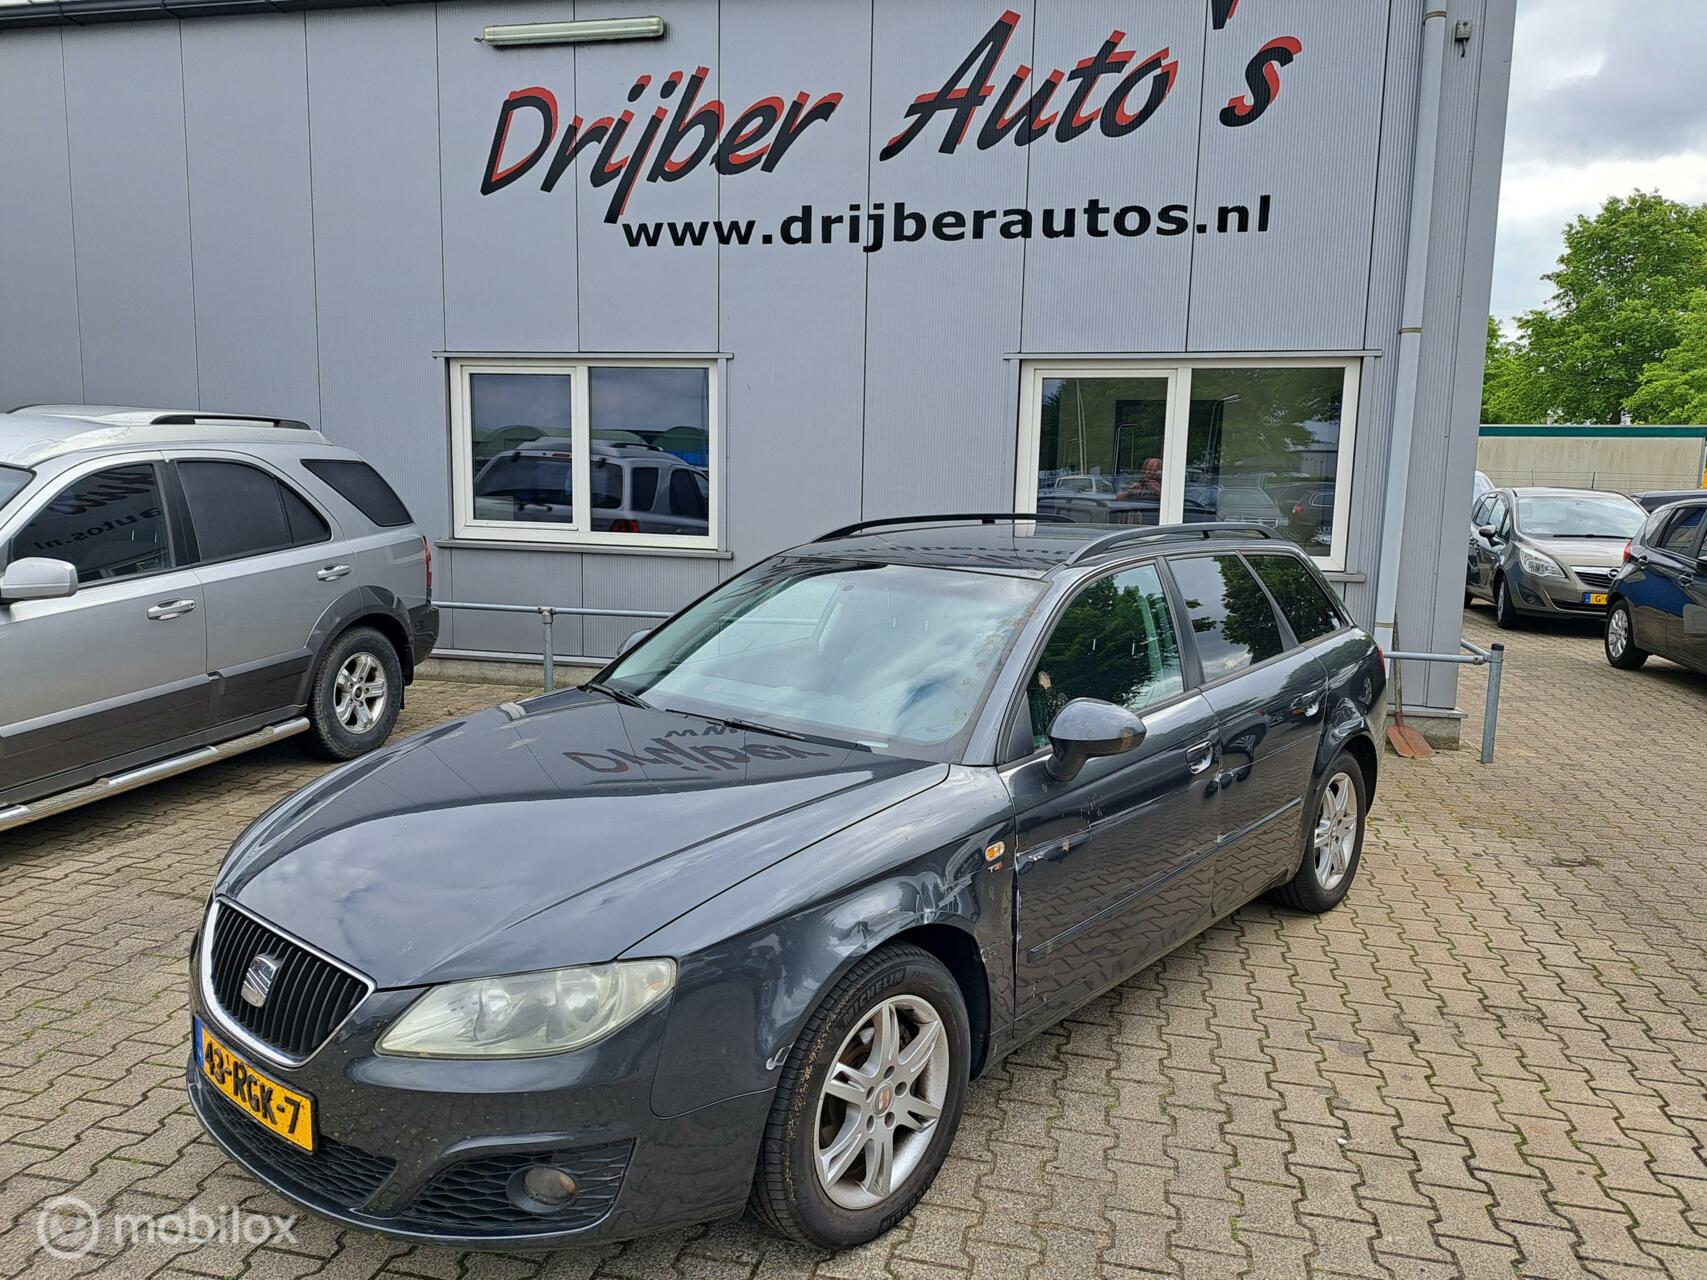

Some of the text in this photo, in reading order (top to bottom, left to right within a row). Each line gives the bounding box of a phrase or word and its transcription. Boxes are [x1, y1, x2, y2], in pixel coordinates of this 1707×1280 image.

[480, 65, 844, 224] Drijber
[622, 195, 1272, 253] www.drijberautos.nl
[205, 1040, 301, 1134] 43-RGK-7
